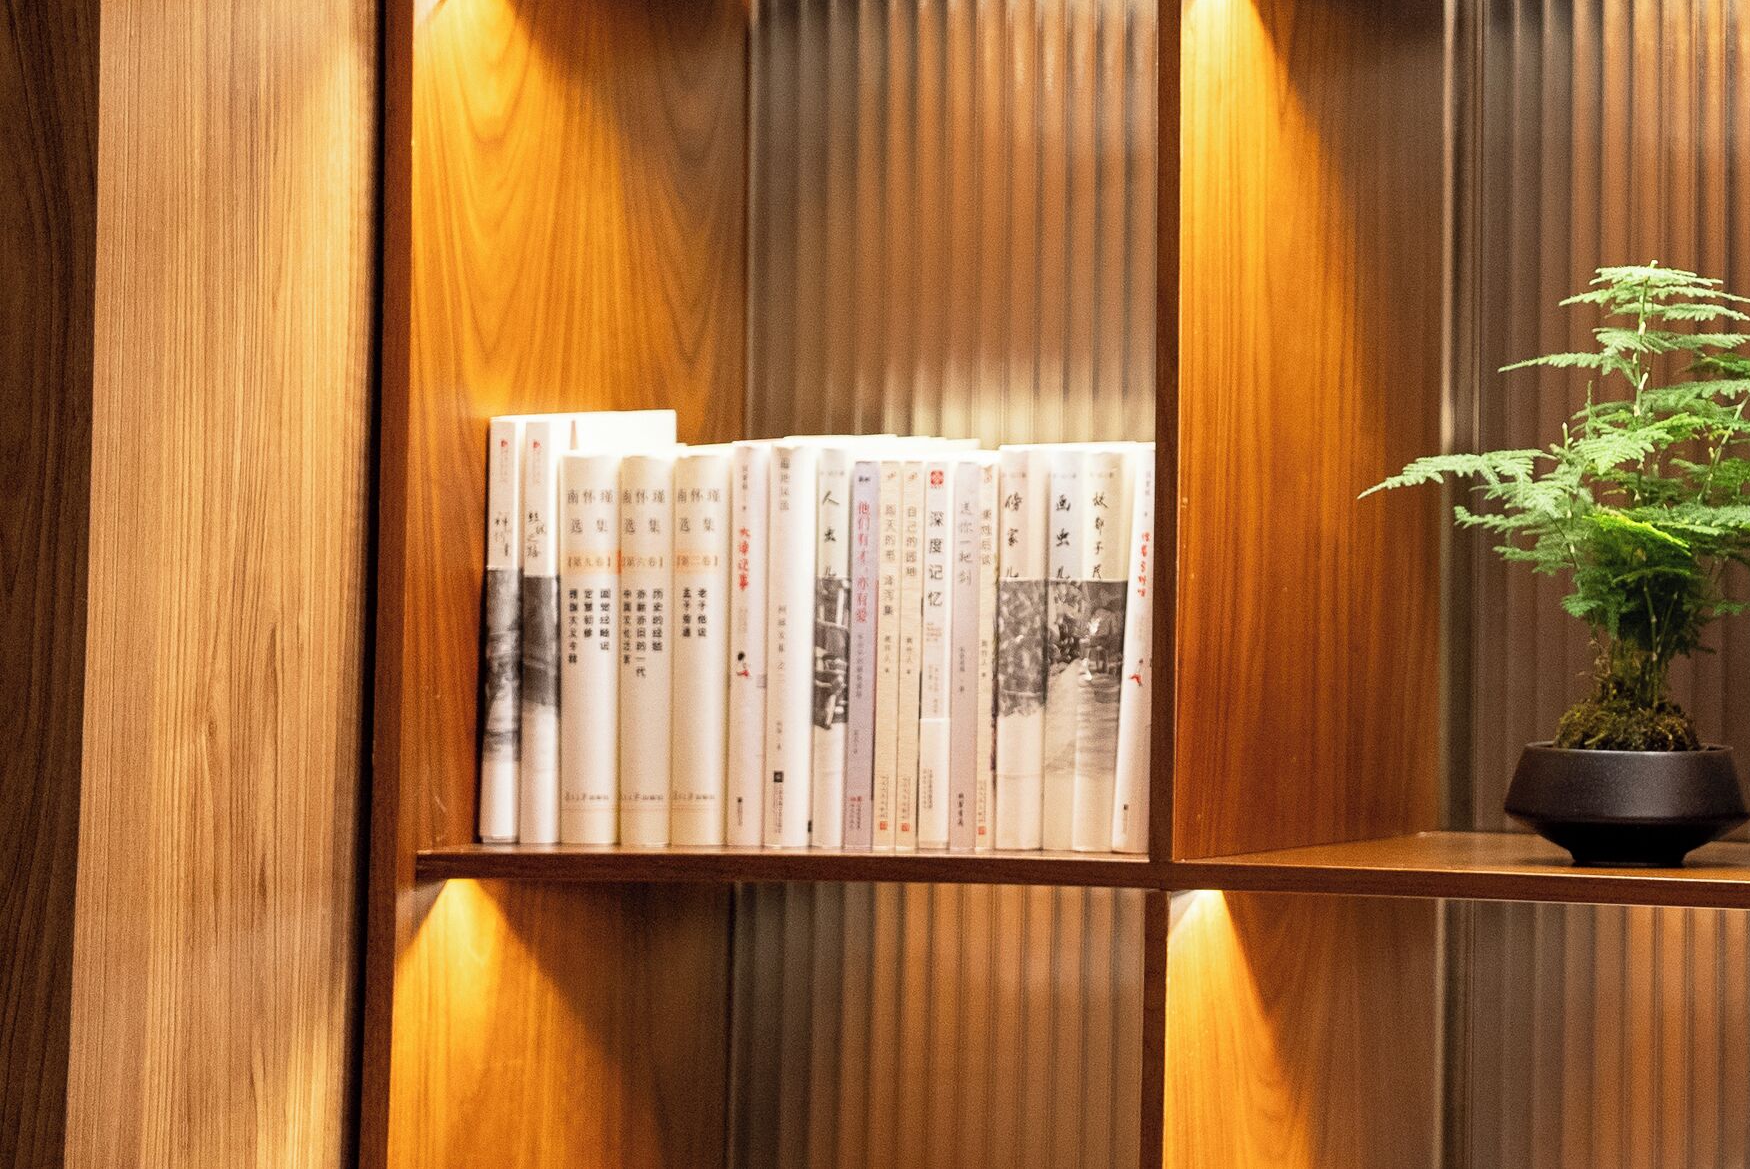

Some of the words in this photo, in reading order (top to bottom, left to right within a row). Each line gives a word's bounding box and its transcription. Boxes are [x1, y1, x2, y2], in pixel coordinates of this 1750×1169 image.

[567, 489, 613, 503] 南怀瑾
[622, 489, 665, 503] 南怀瑾
[677, 488, 720, 503] 南怀瑾
[570, 517, 608, 533] 选集
[624, 517, 660, 534] 选集
[680, 517, 714, 533] 选集
[822, 490, 840, 577] 人虫儿
[906, 505, 917, 577] 自己的园地
[959, 502, 973, 586] 送你一把剑
[1056, 494, 1072, 580] 画虫儿
[928, 511, 944, 607] 深度记忆
[652, 588, 664, 651] 历史的经验
